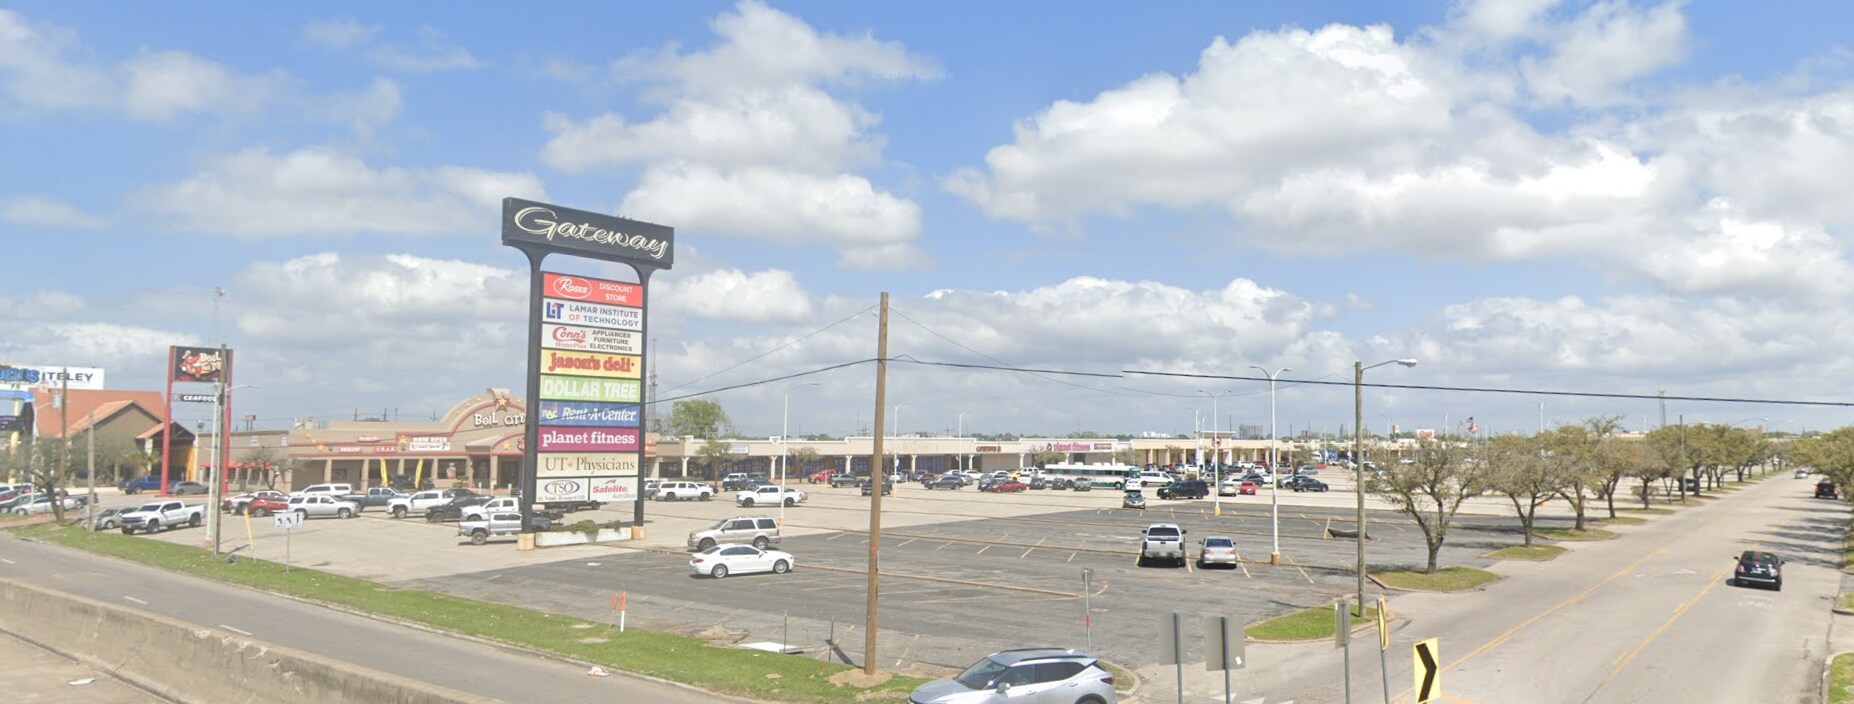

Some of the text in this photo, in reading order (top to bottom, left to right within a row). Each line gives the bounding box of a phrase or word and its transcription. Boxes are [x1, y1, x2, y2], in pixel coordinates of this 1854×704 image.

[514, 206, 669, 260] Gateway
[599, 283, 633, 293] DISCOUNT
[605, 293, 627, 302] STORE
[569, 304, 639, 318] LAMAR INSTITUTE
[584, 315, 639, 327] TECHNOLOGY
[552, 326, 587, 342] Conn's
[592, 329, 631, 339] APPLIANCES
[593, 336, 629, 345] FURNITURE
[589, 342, 632, 352] ELECTRONICS
[603, 356, 632, 372] deli
[543, 379, 639, 399] DOLLAR TREE
[542, 431, 635, 447] planet fitness
[545, 456, 635, 474] UT Physicians
[551, 482, 574, 494] TSO
